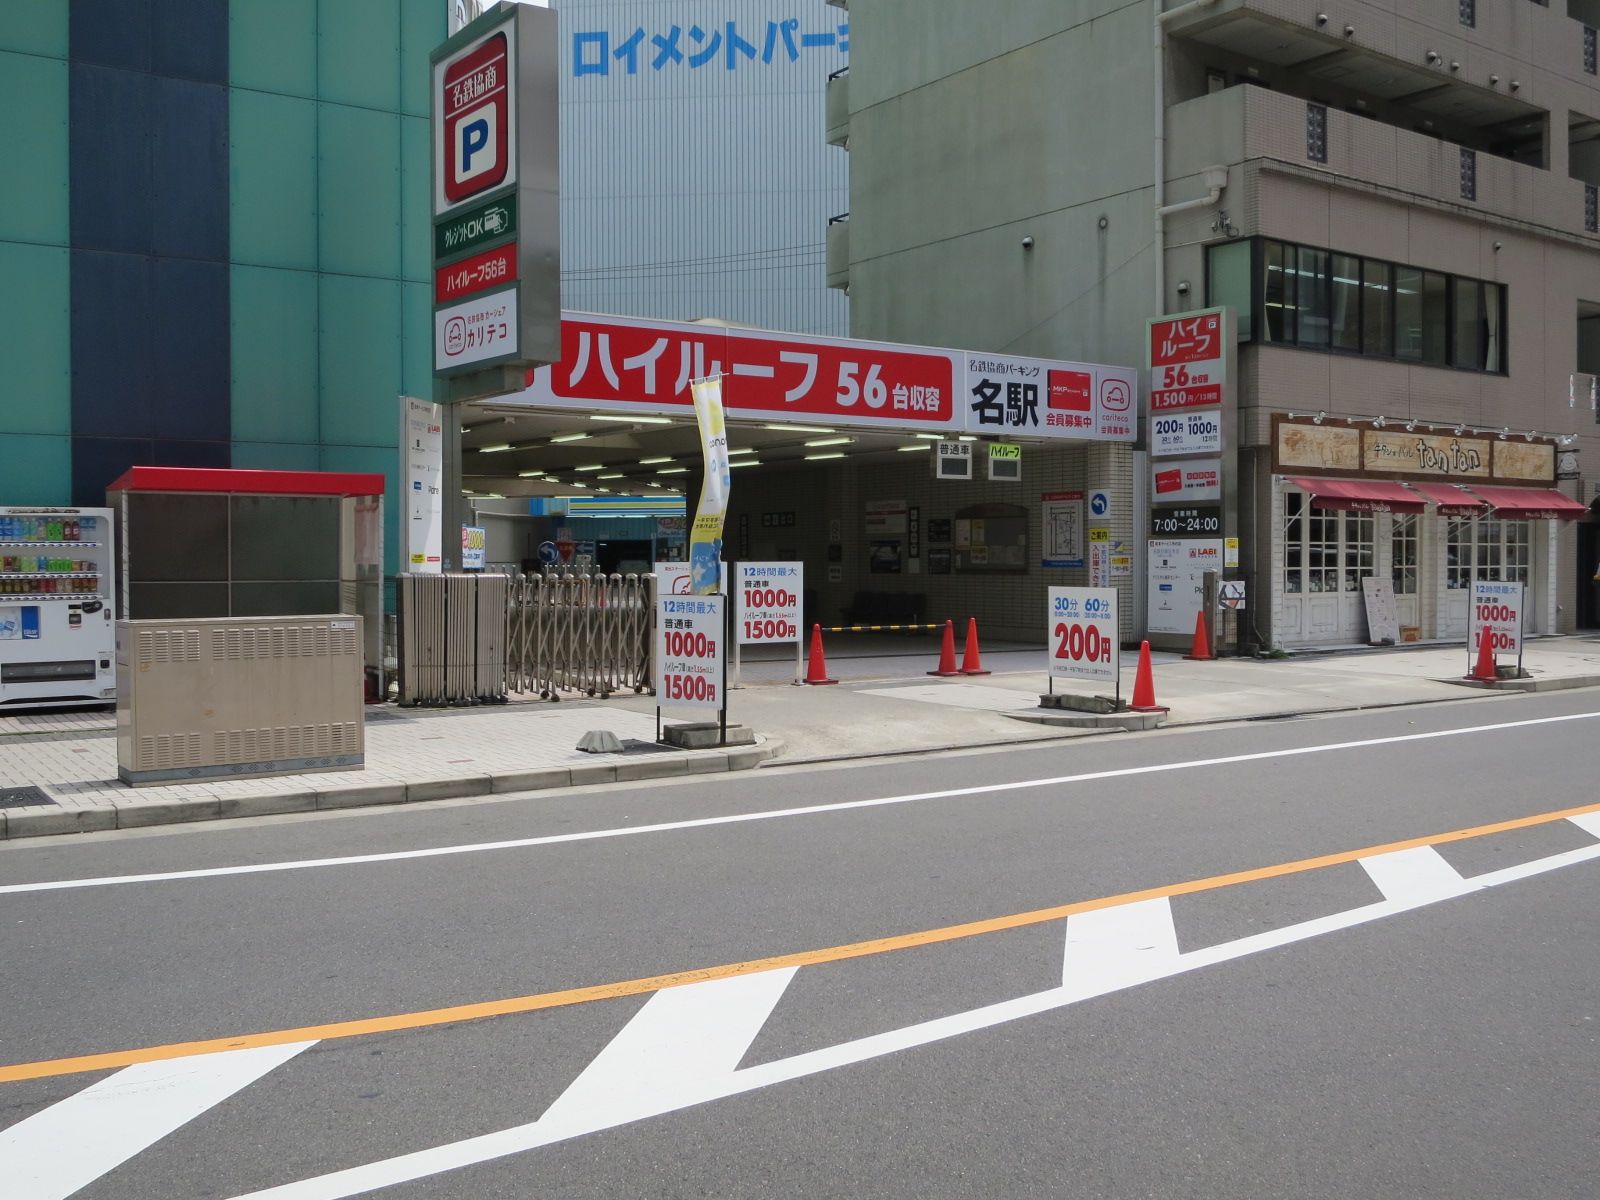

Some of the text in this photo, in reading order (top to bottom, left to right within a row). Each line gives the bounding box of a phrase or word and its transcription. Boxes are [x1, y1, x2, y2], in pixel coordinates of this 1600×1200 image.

[452, 66, 497, 108] 名鉄協商
[462, 118, 489, 173] P
[447, 257, 507, 292] ハイルーフ56台
[467, 323, 507, 348] カリテコ
[1169, 318, 1202, 339] ハイ
[1160, 334, 1211, 357] ルーフ
[569, 331, 819, 403] ハイルーフ
[971, 378, 1039, 427] 名駅
[1046, 413, 1092, 428] 会員募集中
[1155, 420, 1184, 434] 200円
[1188, 422, 1218, 435] 1000円
[940, 444, 970, 455] 普通車
[990, 446, 1020, 458] ハイルーフ
[744, 567, 798, 577] 12時間最大
[744, 580, 769, 588] 普通車
[1475, 585, 1518, 594] 12時間最大
[663, 600, 717, 614] 12時間最大
[744, 589, 797, 608] 1000円
[1054, 597, 1110, 612] 30分 60分
[1475, 605, 1516, 622] 1000円
[664, 618, 694, 629] 普通車
[744, 620, 797, 639] 1500円
[664, 632, 716, 658] 1000円
[1054, 622, 1111, 663] 200円
[1475, 632, 1516, 650] 100円
[664, 675, 716, 701] 1500円
